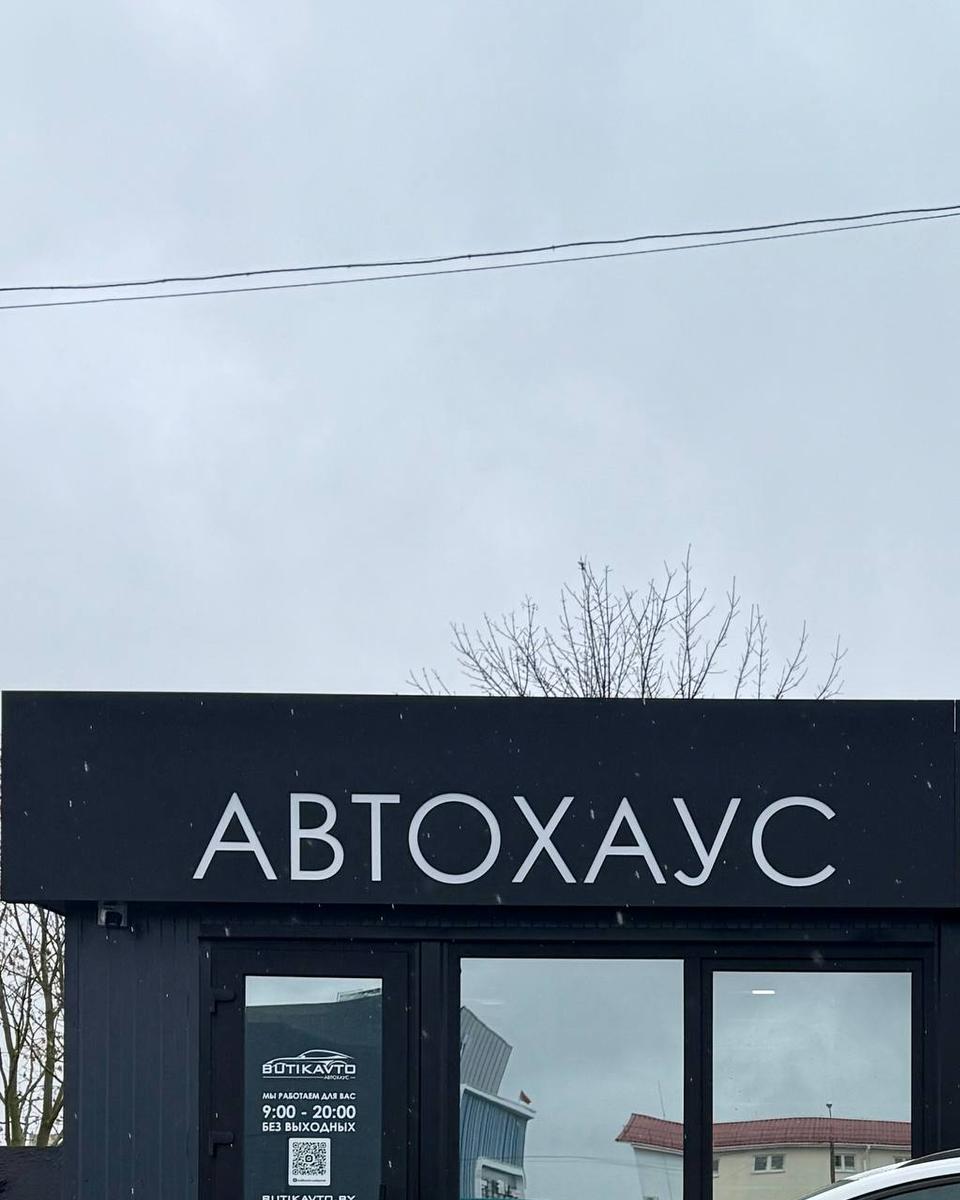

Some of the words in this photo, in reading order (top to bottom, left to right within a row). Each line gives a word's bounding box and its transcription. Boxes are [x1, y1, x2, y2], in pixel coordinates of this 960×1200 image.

[192, 792, 836, 887] АВТОХАУС
[262, 1064, 356, 1074] BUTIKAVTO
[262, 1092, 276, 1100] МЫ
[278, 1092, 320, 1100] РАБОТАЕМ
[321, 1092, 337, 1101] ДЛЯ
[339, 1092, 356, 1100] ВАС
[262, 1105, 296, 1119] 9:00
[312, 1105, 356, 1119] 20:00
[262, 1122, 281, 1132] БЕЗ
[285, 1122, 356, 1133] ВЫХОДНЫХ
